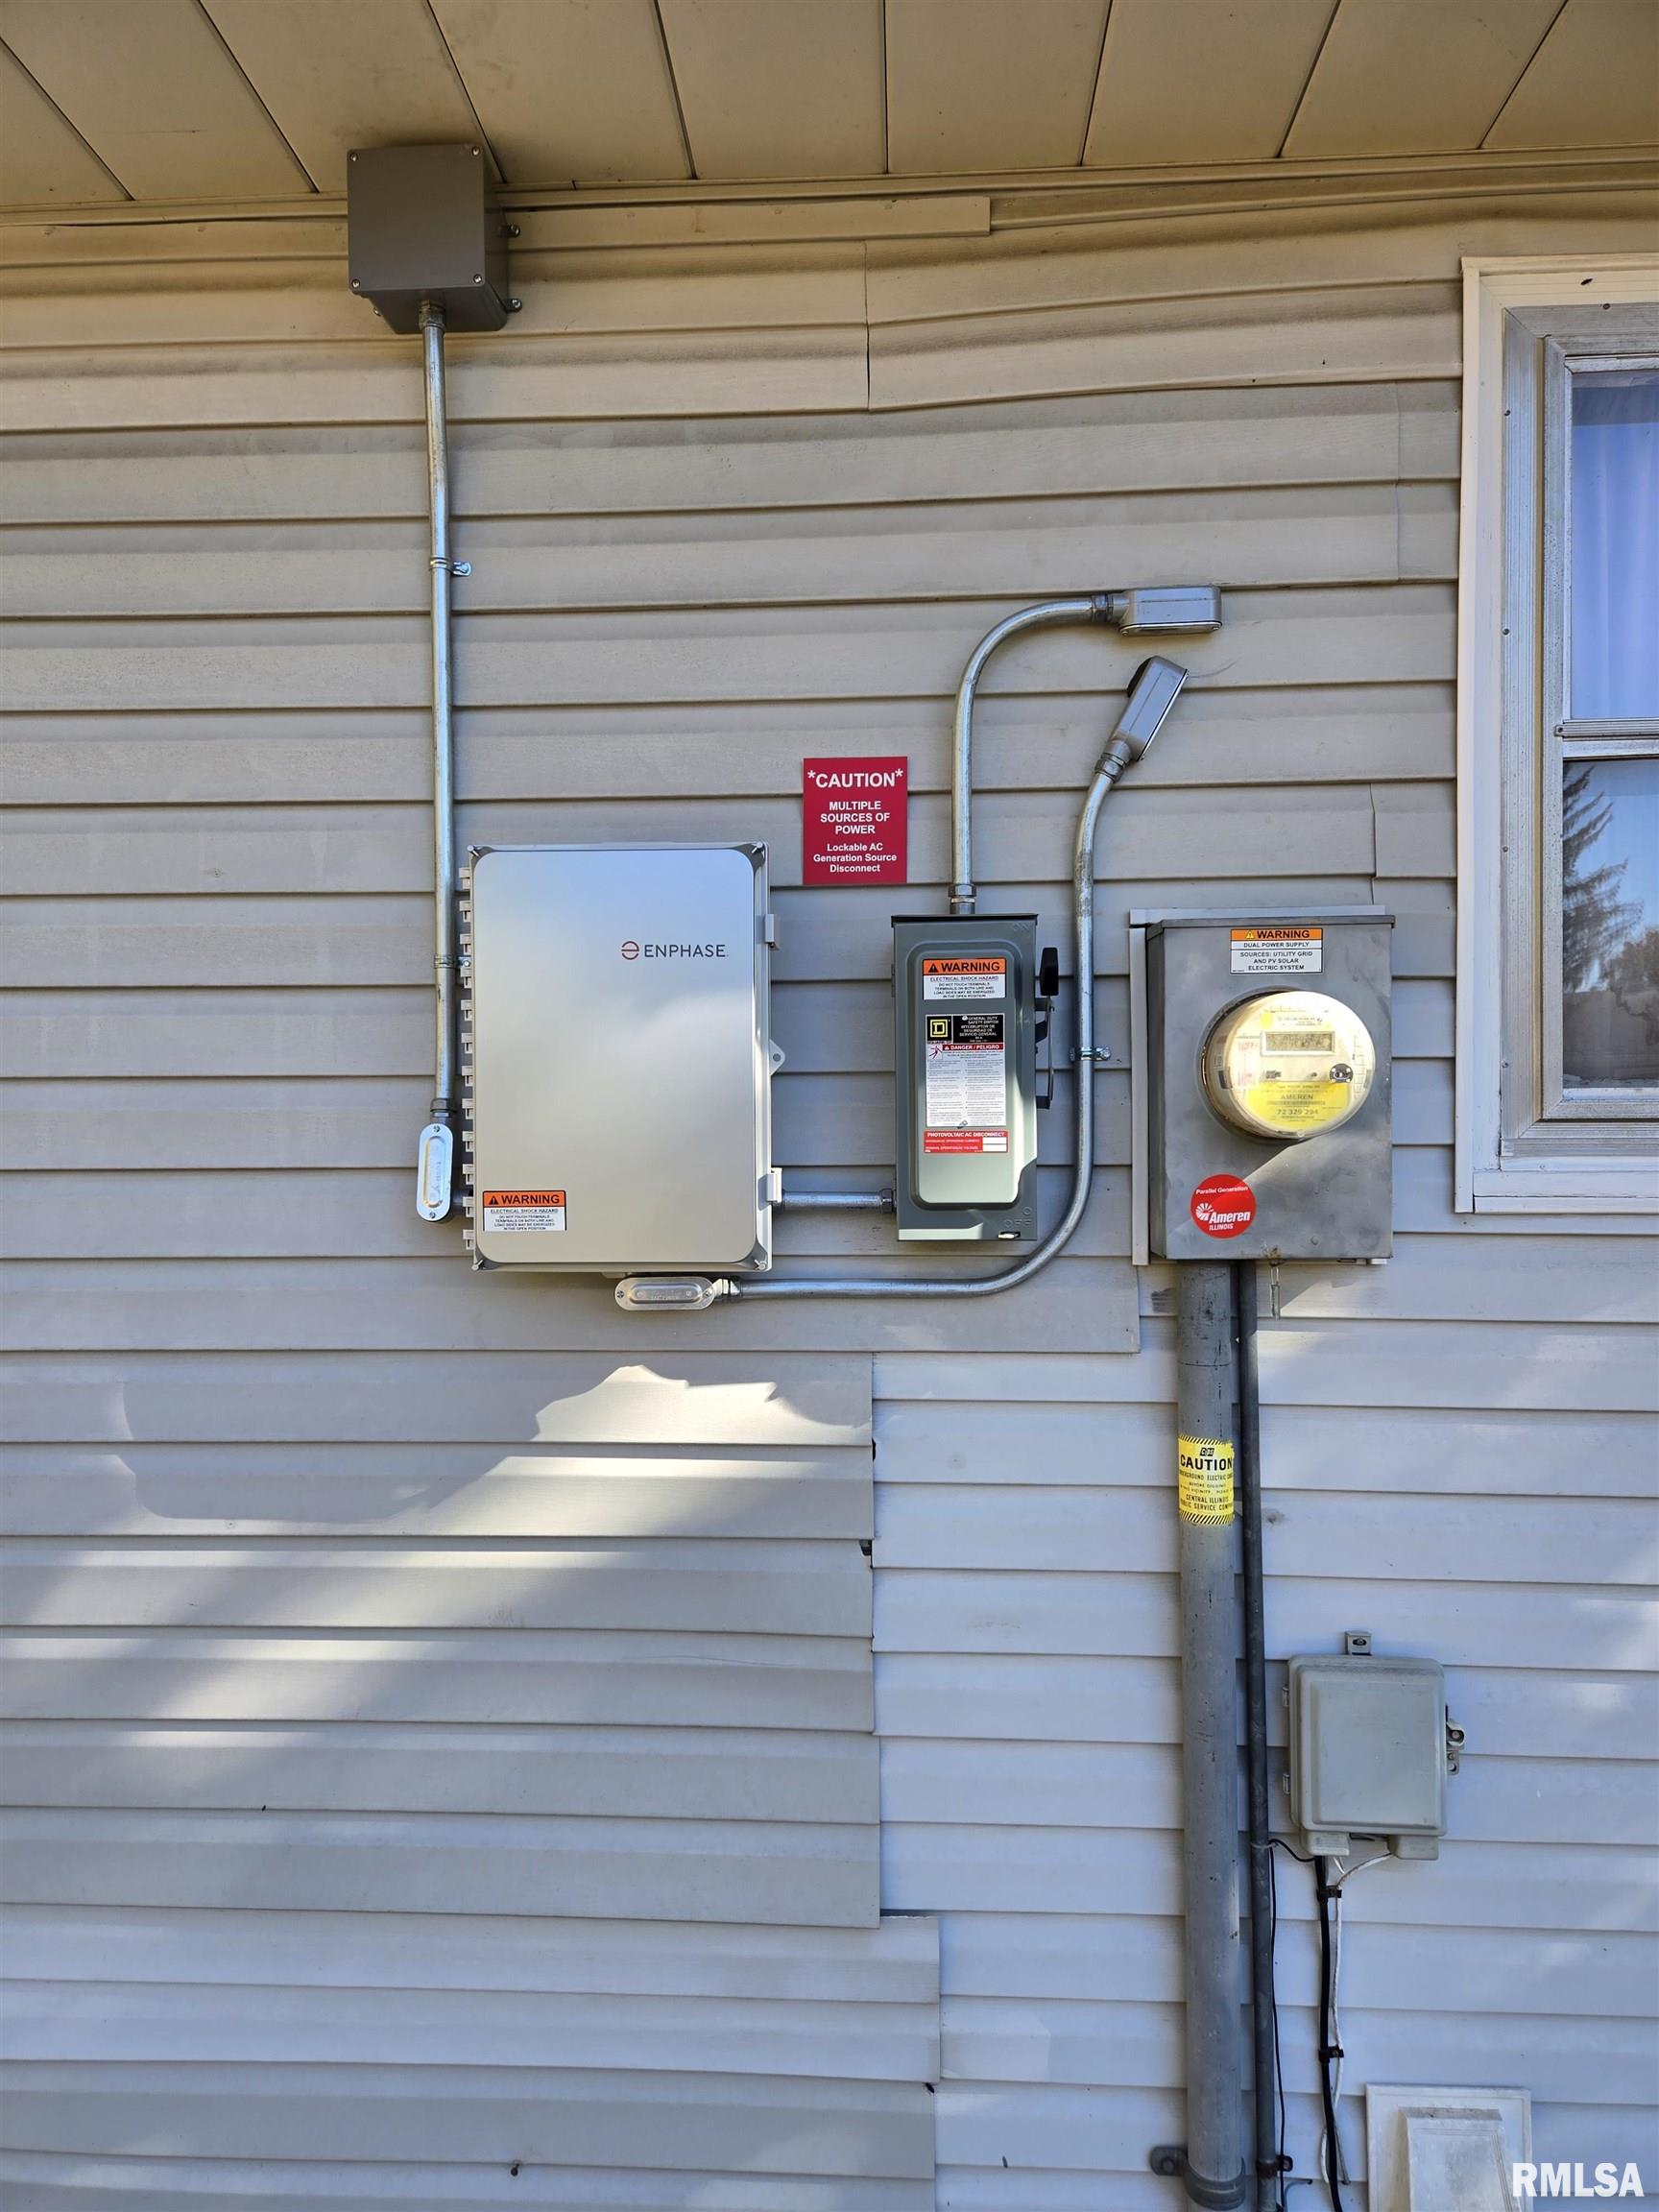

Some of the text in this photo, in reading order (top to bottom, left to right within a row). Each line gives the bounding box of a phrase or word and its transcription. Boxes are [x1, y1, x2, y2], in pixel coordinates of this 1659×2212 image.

[830, 801, 881, 810] MULTIPLE
[820, 813, 890, 822] SOURCES OF
[835, 825, 875, 834] POWER
[828, 843, 867, 852] Lockable
[830, 864, 880, 873] Disconnect
[644, 945, 726, 957] ENPHASE
[942, 962, 999, 972] WARNING
[501, 1194, 559, 1204] WARNING
[1209, 1212, 1250, 1223] Ameren
[1180, 1455, 1232, 1470] CAUTION
[1186, 1494, 1208, 1503] CENTRAL
